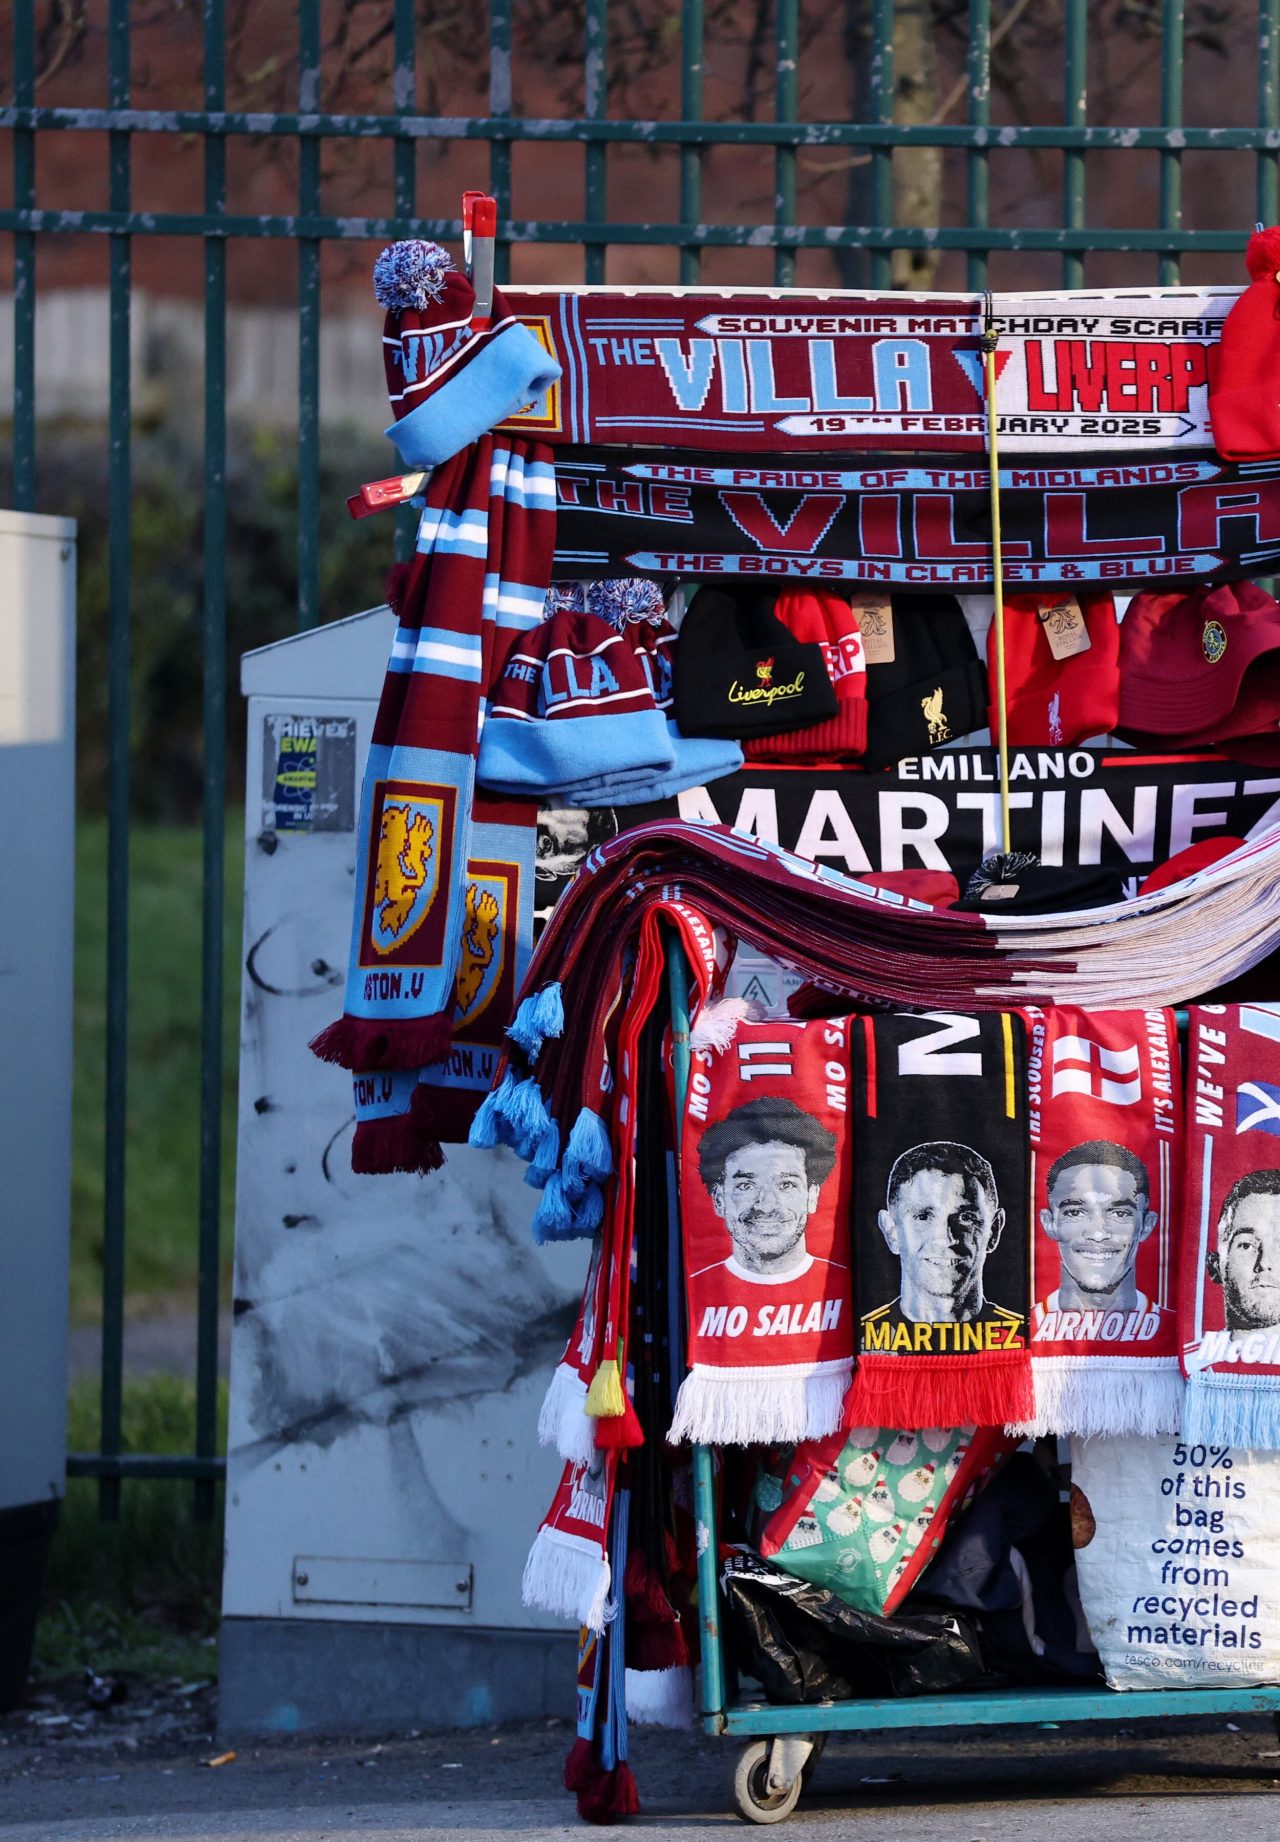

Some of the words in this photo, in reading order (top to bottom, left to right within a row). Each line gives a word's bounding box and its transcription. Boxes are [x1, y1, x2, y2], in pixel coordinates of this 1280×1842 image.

[717, 318, 896, 333] SOUVENIR
[908, 318, 1100, 334] MATCHDAY
[589, 338, 655, 366] THE
[653, 338, 933, 414] VILLA
[1024, 339, 1221, 414] LIVERP
[1080, 419, 1162, 434] 2025
[644, 465, 715, 483] THE
[732, 470, 843, 489] PRIDE
[860, 471, 908, 488] OF
[925, 471, 992, 488] THE
[1011, 464, 1200, 487] MIDLANDS
[556, 475, 693, 519] THE
[654, 554, 725, 571] THE
[738, 556, 844, 576] BOYS
[858, 562, 891, 579] IN
[1061, 564, 1085, 579] &
[1099, 556, 1196, 577] BLUE
[504, 663, 537, 683] THE
[728, 672, 805, 706] Liverpool
[899, 752, 1095, 781] EMILIANO
[738, 1042, 793, 1082] 11
[1027, 1024, 1046, 1104] SCOUSER
[1195, 1024, 1227, 1128] WE'VE
[825, 1061, 847, 1112] MO
[1154, 1097, 1174, 1134] IT'S
[697, 1305, 749, 1338] MO
[753, 1298, 843, 1337] SALAH
[1033, 1310, 1162, 1343] ARNOLD
[863, 1319, 1022, 1352] MARTINEZ
[1172, 1443, 1234, 1470] 50%
[1160, 1473, 1186, 1497] of
[1193, 1473, 1247, 1499] this
[1175, 1503, 1225, 1534] bag
[1151, 1538, 1245, 1559] comes
[1160, 1560, 1230, 1587] from
[1132, 1595, 1259, 1622] recycled
[1127, 1624, 1262, 1649] materials
[1124, 1652, 1265, 1673] tesco.com/recycling
